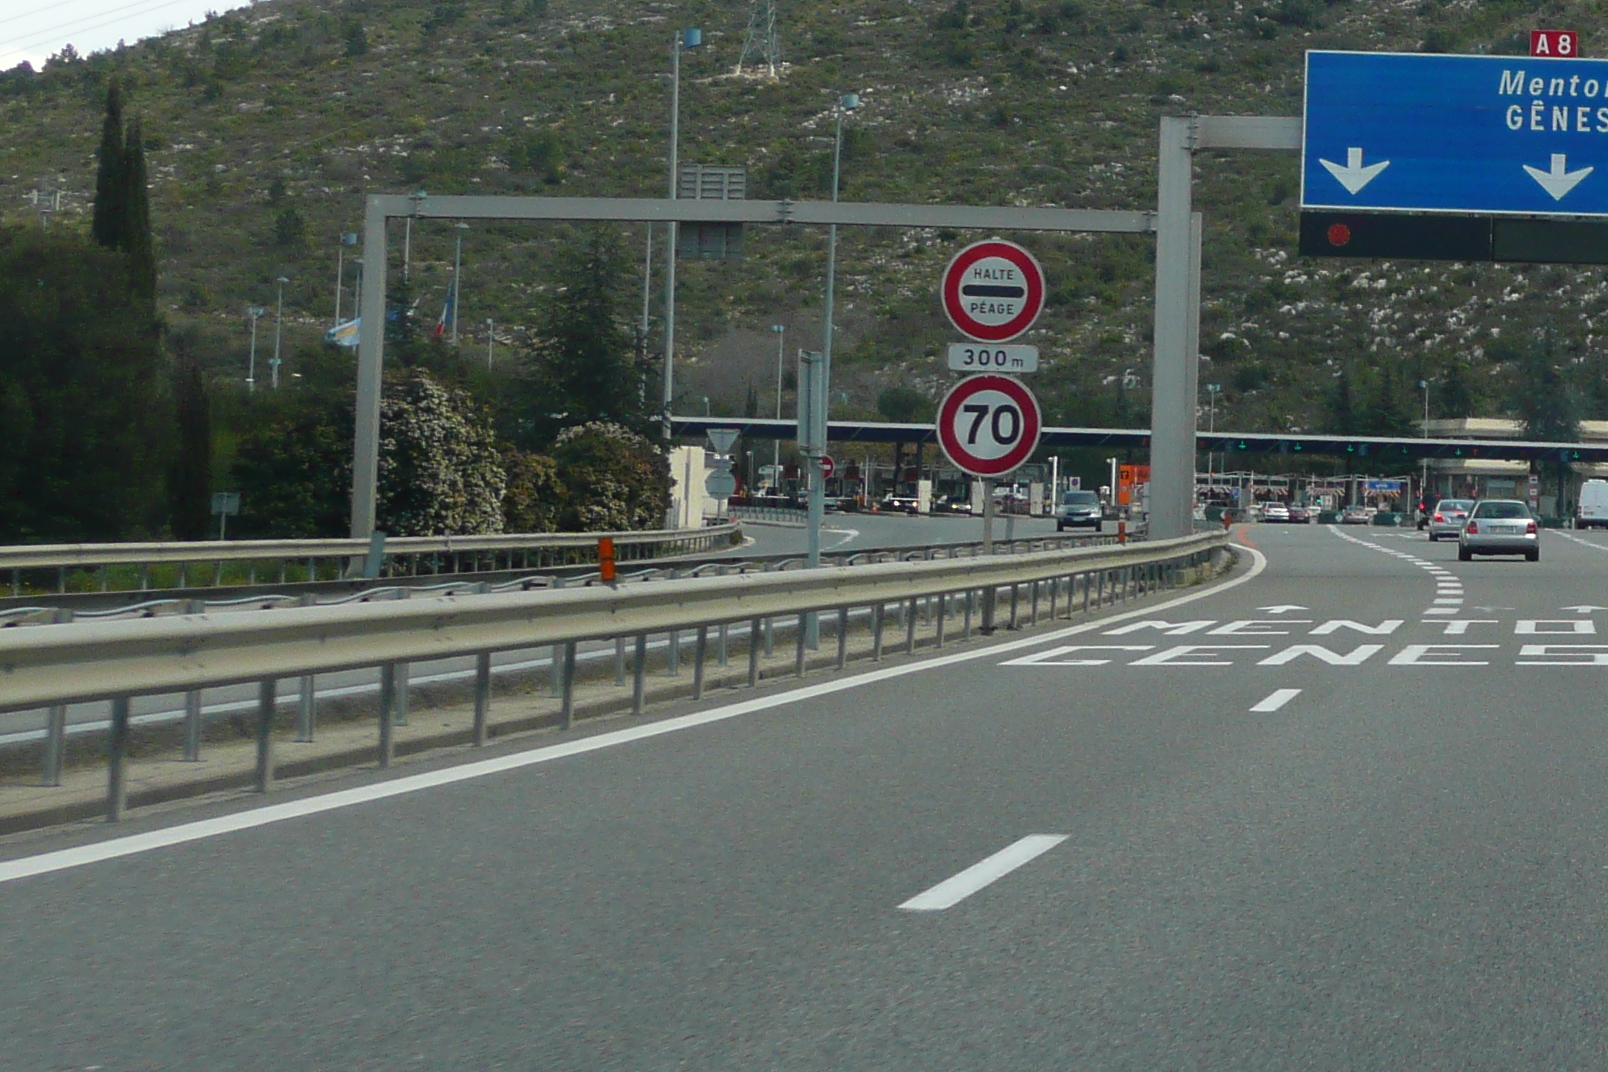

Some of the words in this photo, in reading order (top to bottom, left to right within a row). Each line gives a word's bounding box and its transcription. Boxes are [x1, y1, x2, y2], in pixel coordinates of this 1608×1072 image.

[974, 269, 1014, 280] HALTE
[971, 300, 1014, 314] PÉAGE
[963, 349, 1007, 366] 300
[1012, 357, 1023, 367] m
[963, 404, 1020, 444] 70
